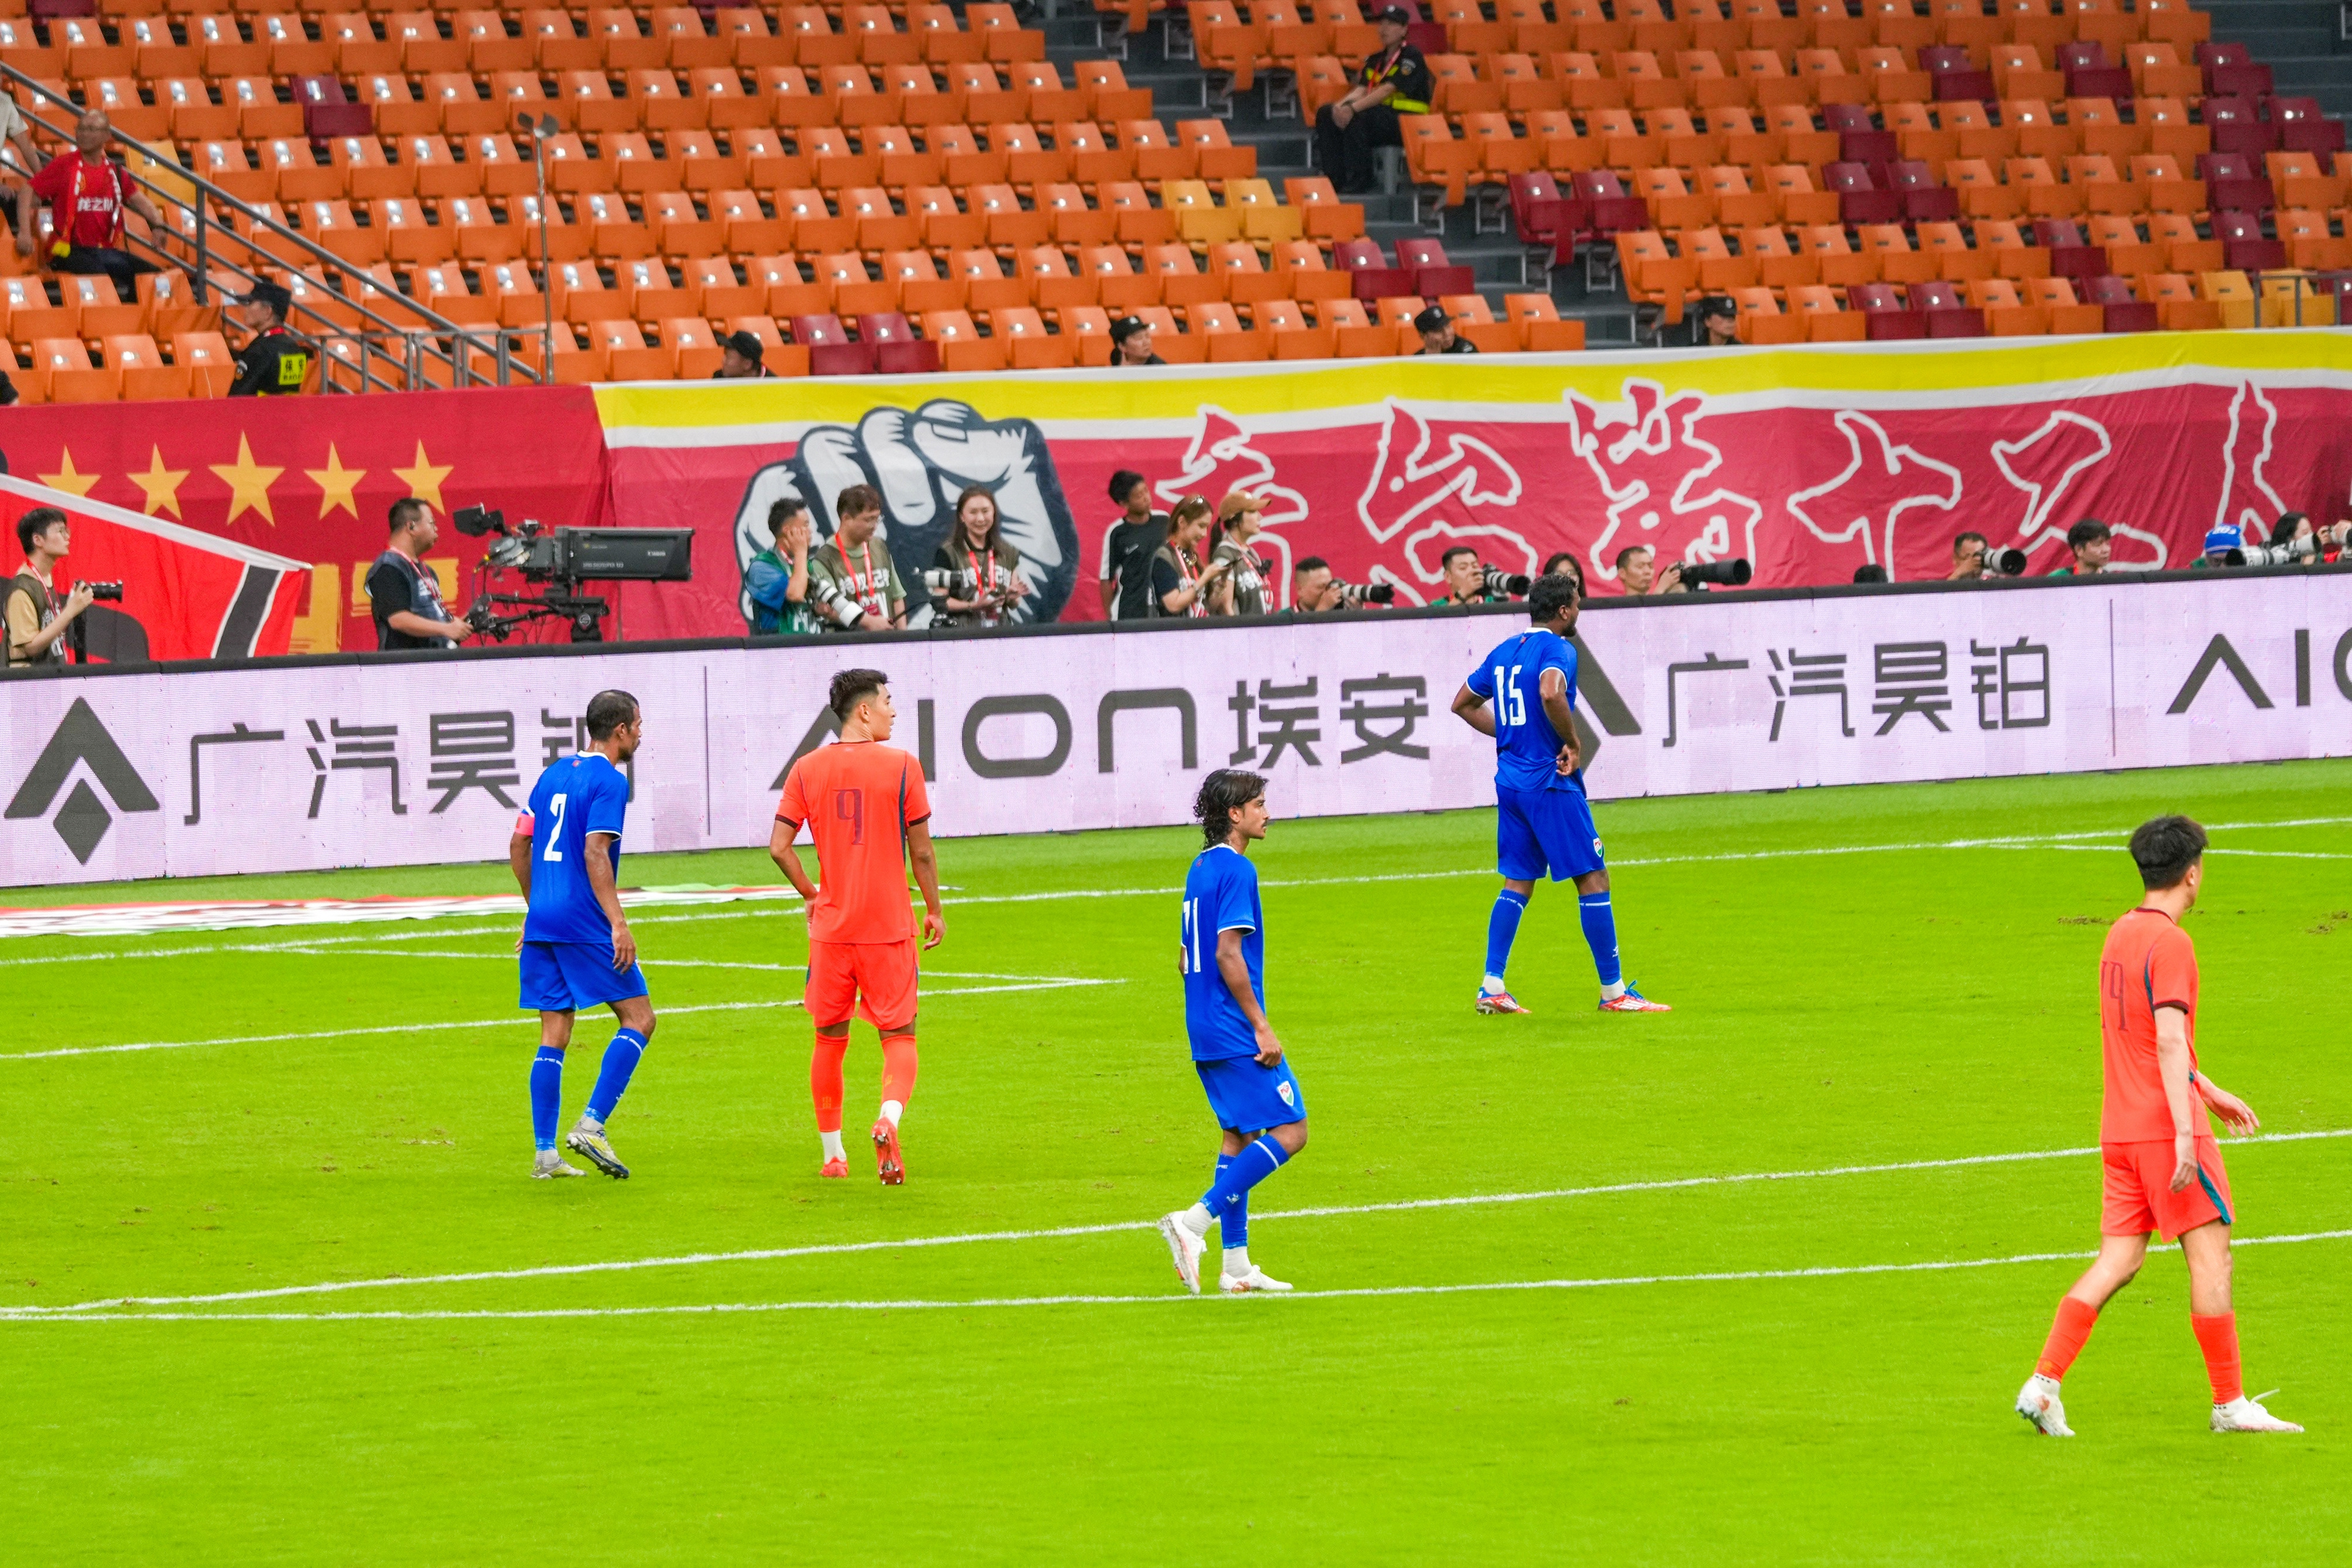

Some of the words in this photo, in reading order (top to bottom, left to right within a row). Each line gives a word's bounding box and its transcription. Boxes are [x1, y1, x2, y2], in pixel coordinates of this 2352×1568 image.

[1493, 665, 1526, 726] 15
[1662, 637, 2051, 748] 广汽昊铂
[2166, 627, 2352, 714] AI
[1228, 673, 1430, 770] 埃安
[544, 793, 568, 861] 2
[835, 788, 864, 845] 9
